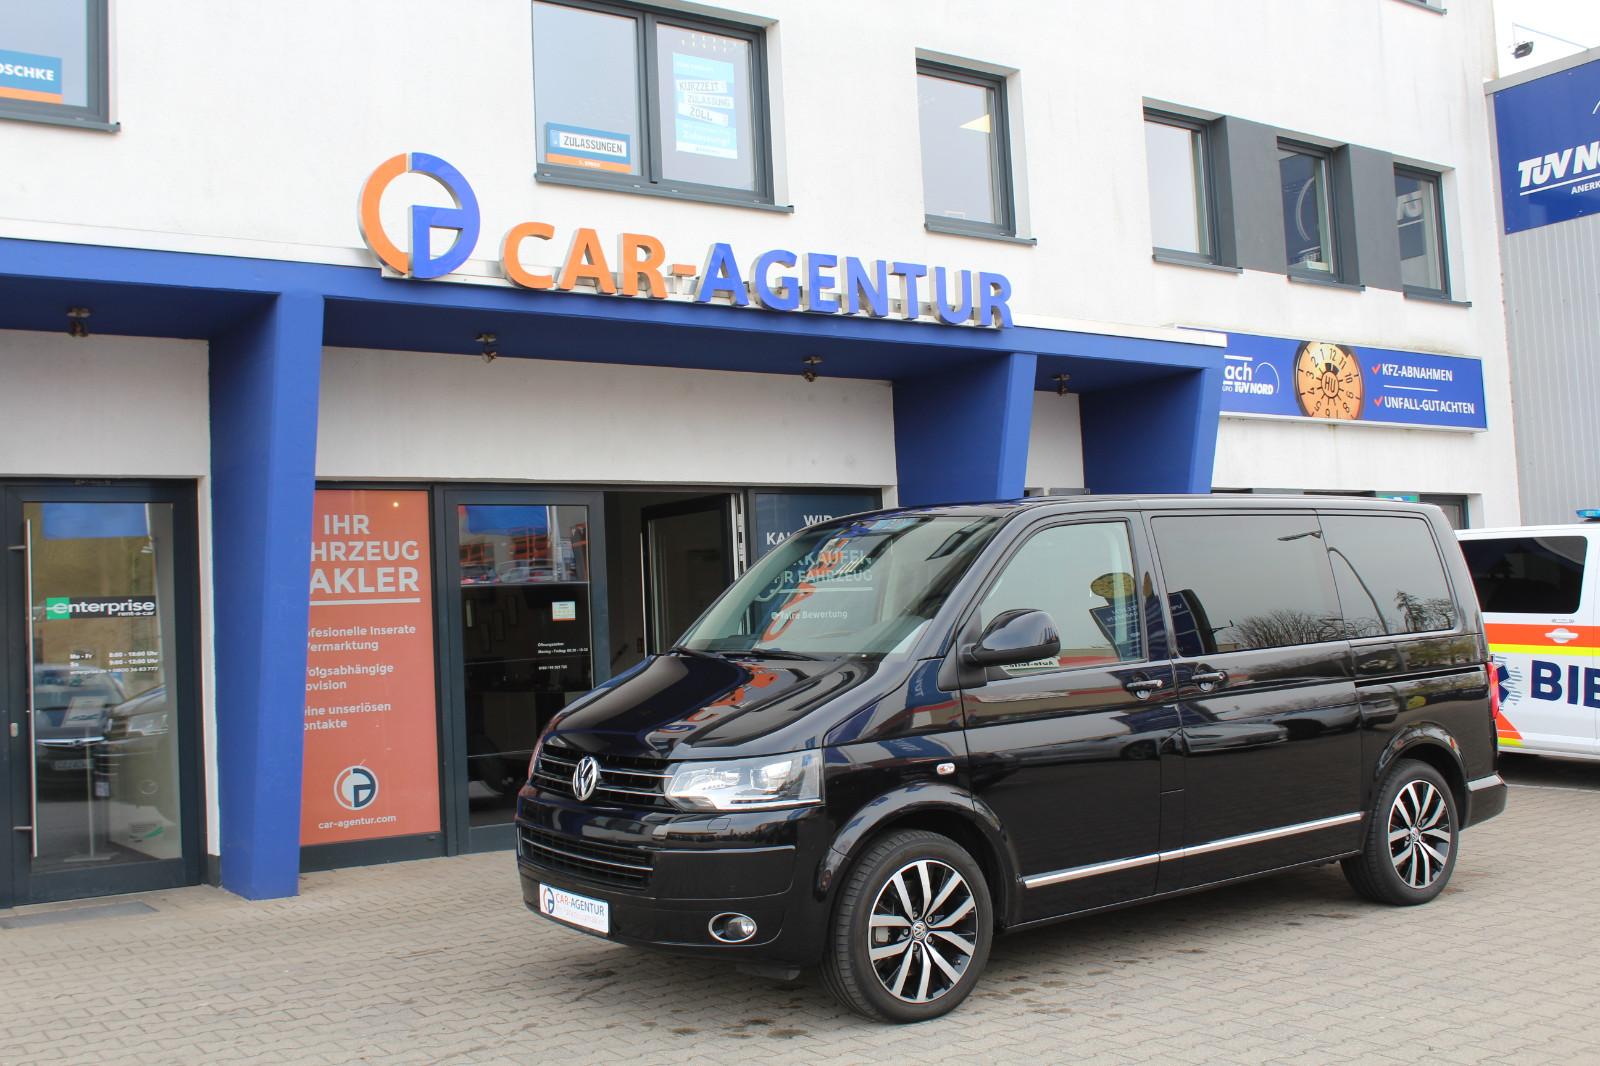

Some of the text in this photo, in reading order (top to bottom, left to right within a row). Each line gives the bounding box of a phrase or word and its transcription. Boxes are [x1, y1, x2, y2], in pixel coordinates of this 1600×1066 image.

[690, 106, 713, 121] ZOLL
[563, 135, 623, 153] ZULASSUNGEN
[1573, 141, 1600, 175] N
[501, 221, 1014, 328] CAR-AGENTUR
[1382, 363, 1453, 382] KFZ-ABNAHMEN
[1250, 383, 1274, 395] NORD
[1324, 375, 1336, 393] HU
[1384, 395, 1475, 414] UNFALL-GUTACHTEN
[324, 513, 370, 535] IHR
[766, 531, 792, 546] KA
[311, 540, 420, 562] HRZEUG
[309, 566, 420, 594] AKLER
[50, 599, 155, 615] enterprise
[802, 610, 848, 620] Bewertung
[308, 625, 416, 638] fesionelle Inserate
[306, 663, 394, 678] olgsabhängige
[1530, 659, 1600, 709] BIE
[328, 702, 392, 714] unseriösen
[318, 815, 397, 829] car-agentur.com
[555, 893, 605, 917] CAR-AGENTUR
